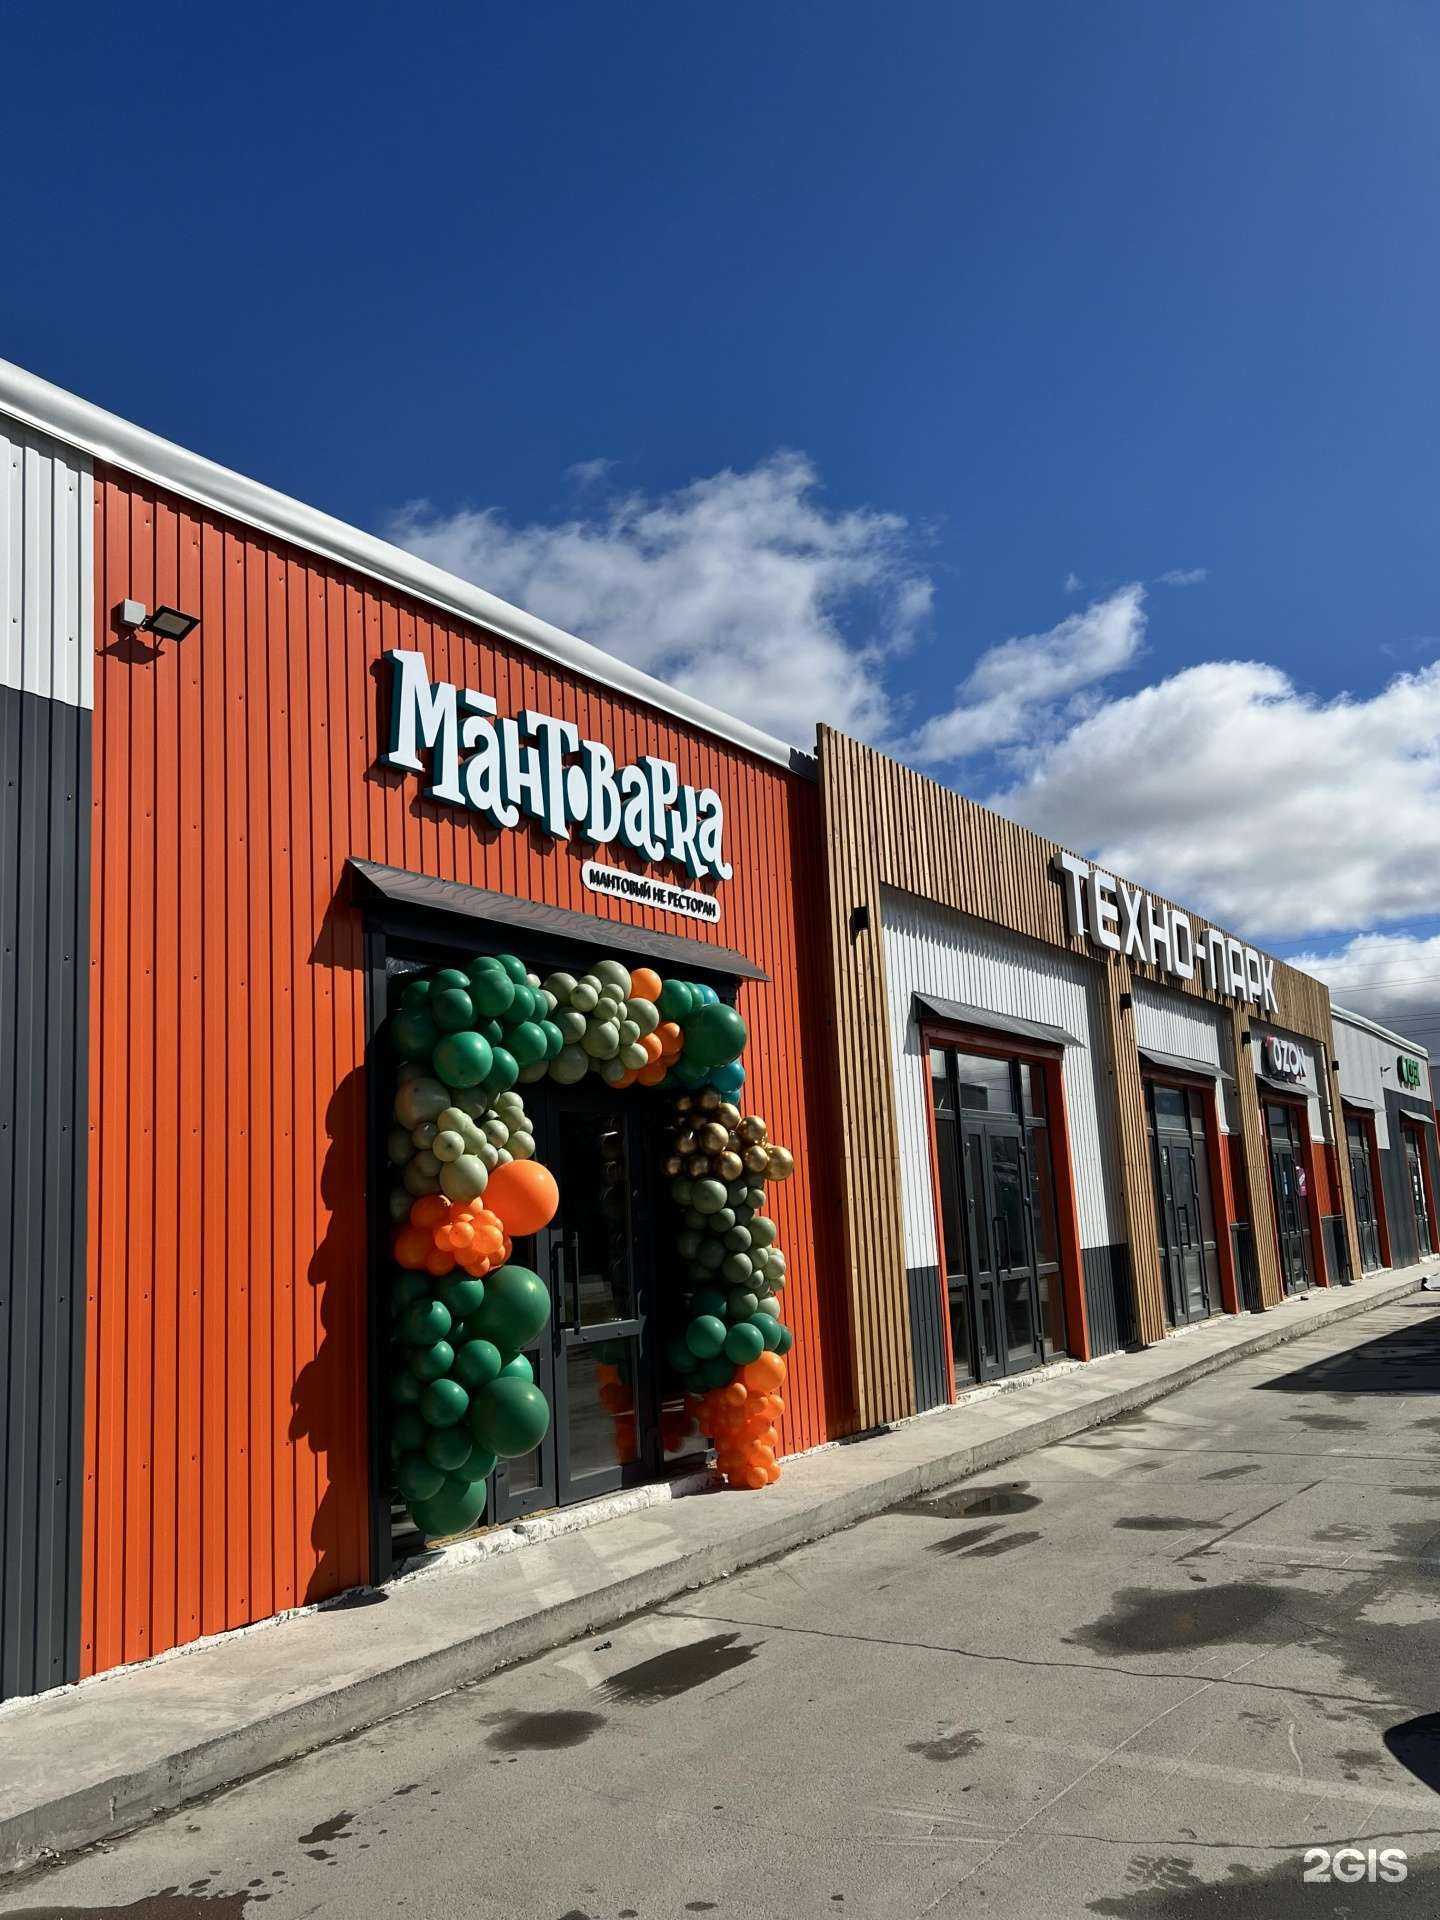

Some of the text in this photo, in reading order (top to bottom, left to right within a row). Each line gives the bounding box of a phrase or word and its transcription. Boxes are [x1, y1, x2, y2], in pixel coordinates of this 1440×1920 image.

[589, 869, 717, 918] МАНТОВЫЙ НЕ РЕСТОРАН
[1055, 851, 1279, 1014] ТЕХНО-ПАРК
